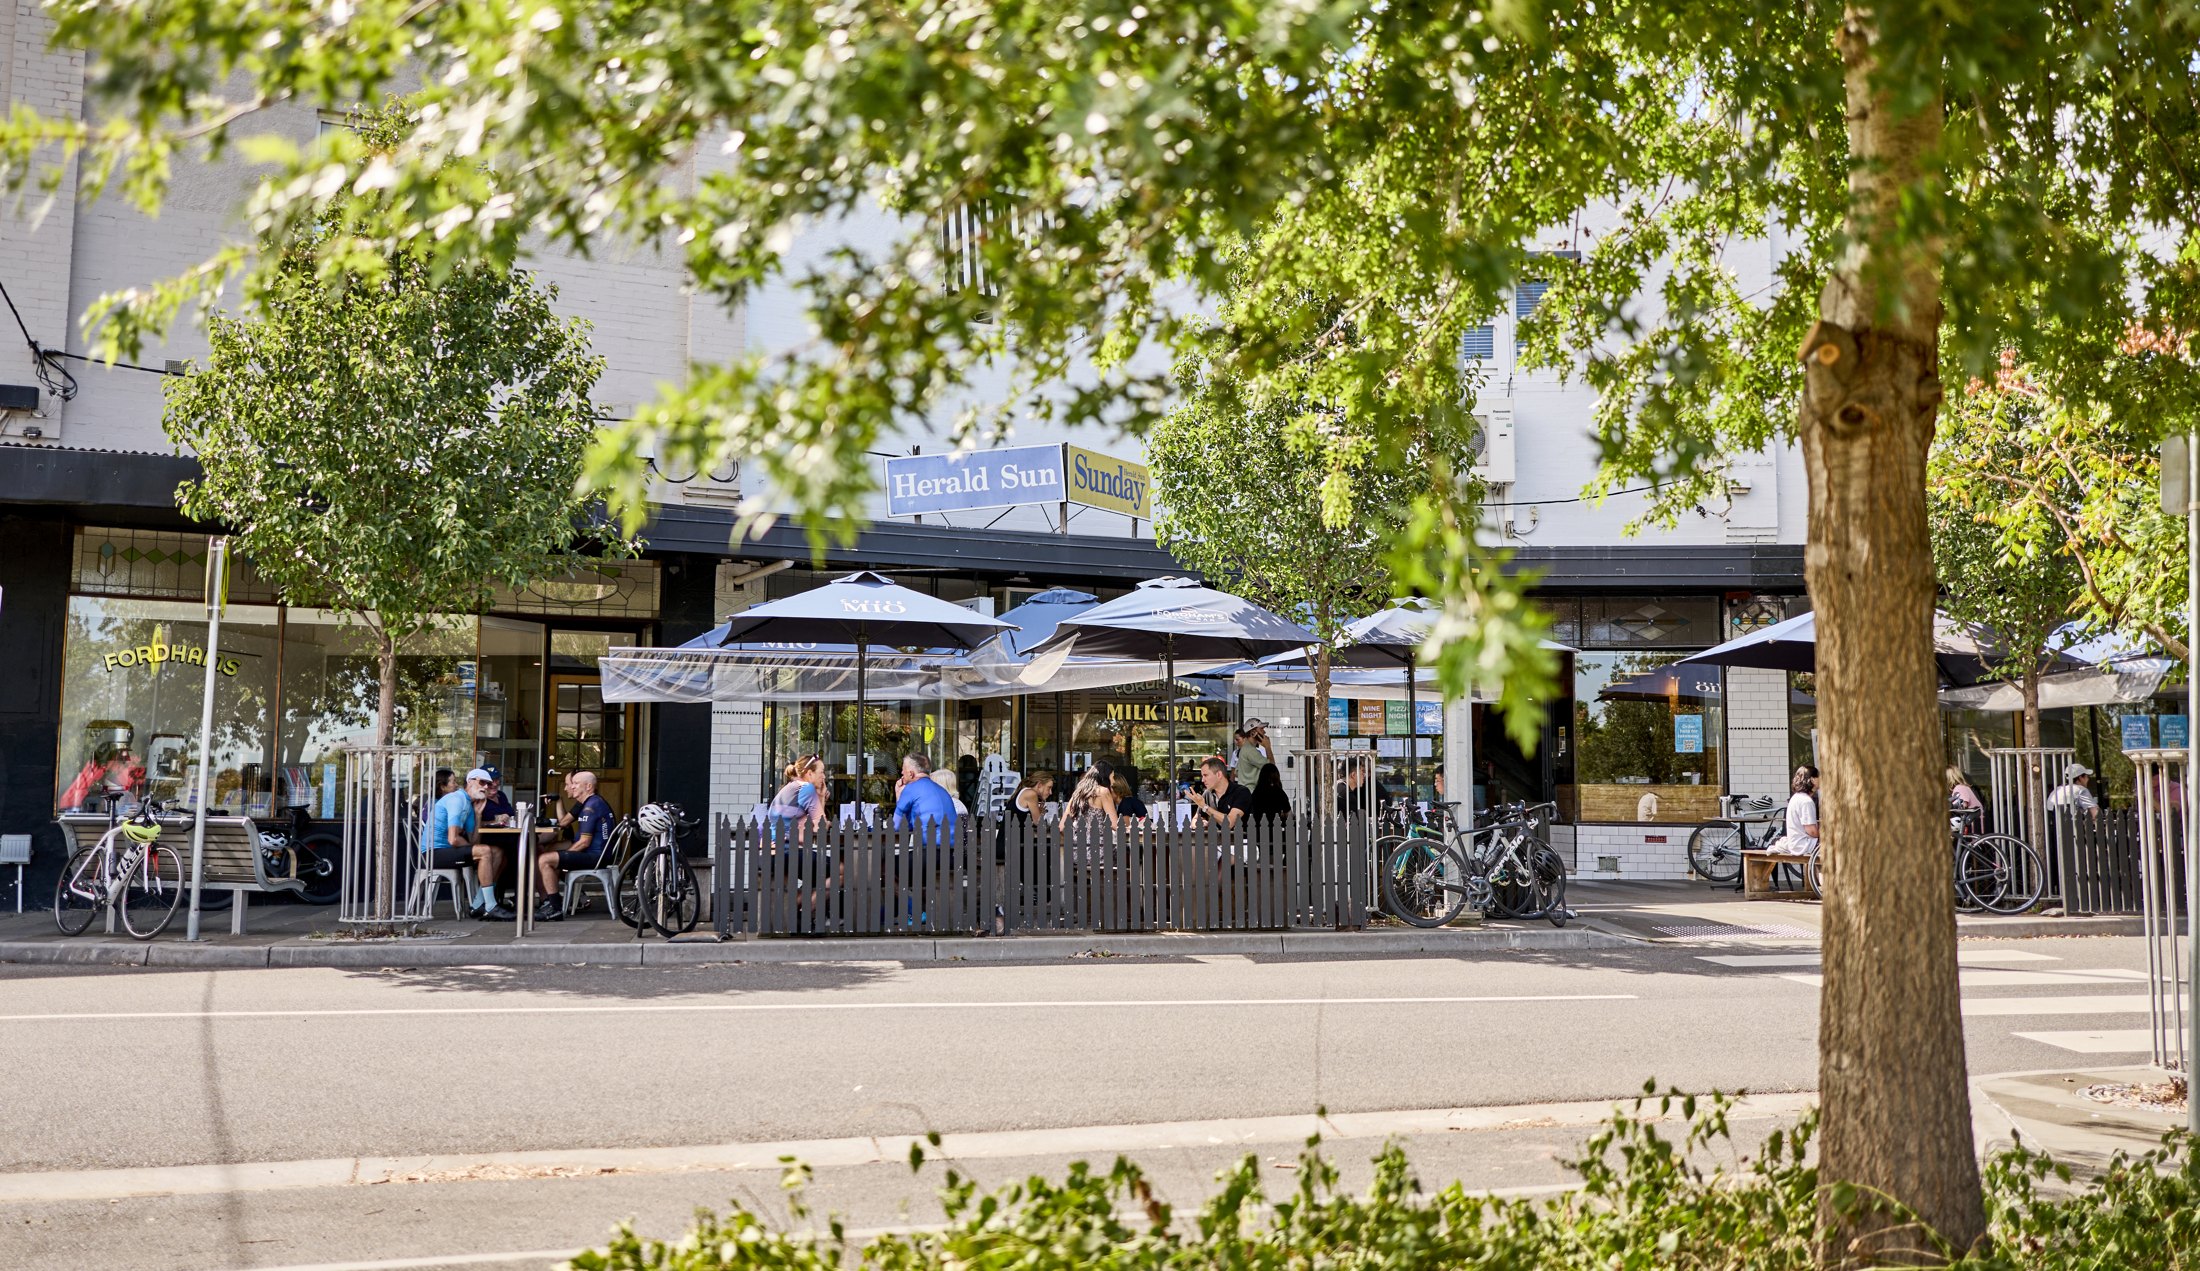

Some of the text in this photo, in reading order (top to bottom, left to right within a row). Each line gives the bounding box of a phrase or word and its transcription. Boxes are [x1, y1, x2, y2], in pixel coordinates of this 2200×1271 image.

[893, 464, 1058, 499] Herald Sun
[1075, 453, 1145, 510] Sunday
[1106, 703, 1209, 723] MILK BAR
